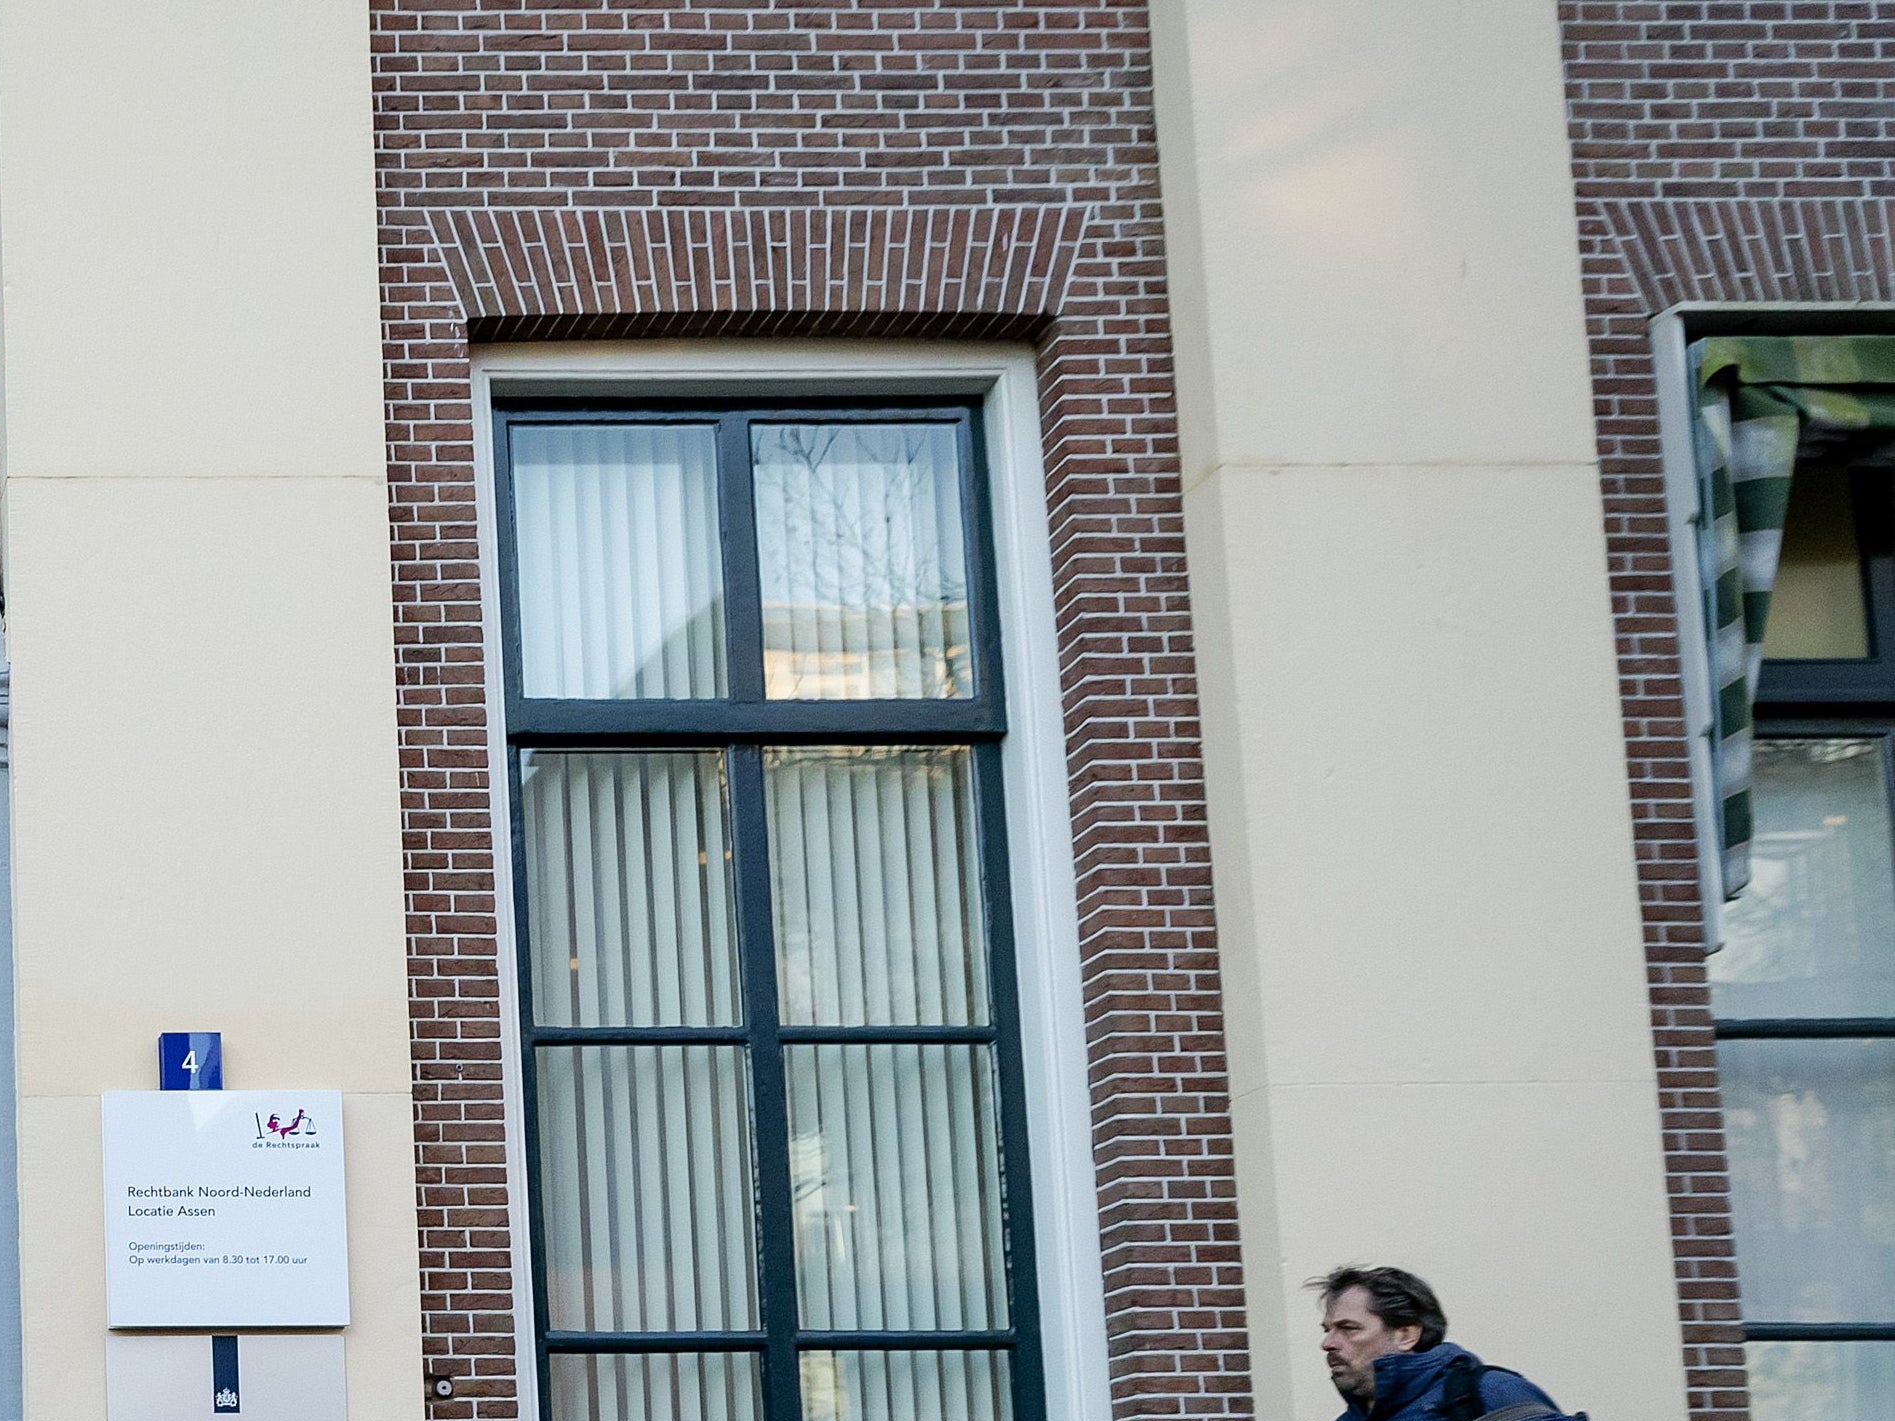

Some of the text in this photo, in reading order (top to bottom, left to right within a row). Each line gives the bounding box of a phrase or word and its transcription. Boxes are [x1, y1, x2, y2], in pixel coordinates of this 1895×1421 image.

[181, 1050, 199, 1074] 4
[251, 1141, 321, 1150] de Rechtspraak
[127, 1186, 311, 1198] Rechtbank Noord-Nederland
[128, 1205, 216, 1217] Locatie Assen
[128, 1241, 205, 1253] Openingstijden:
[129, 1254, 308, 1267] Op werkdagen van 8.30 tot 17.00 uur
